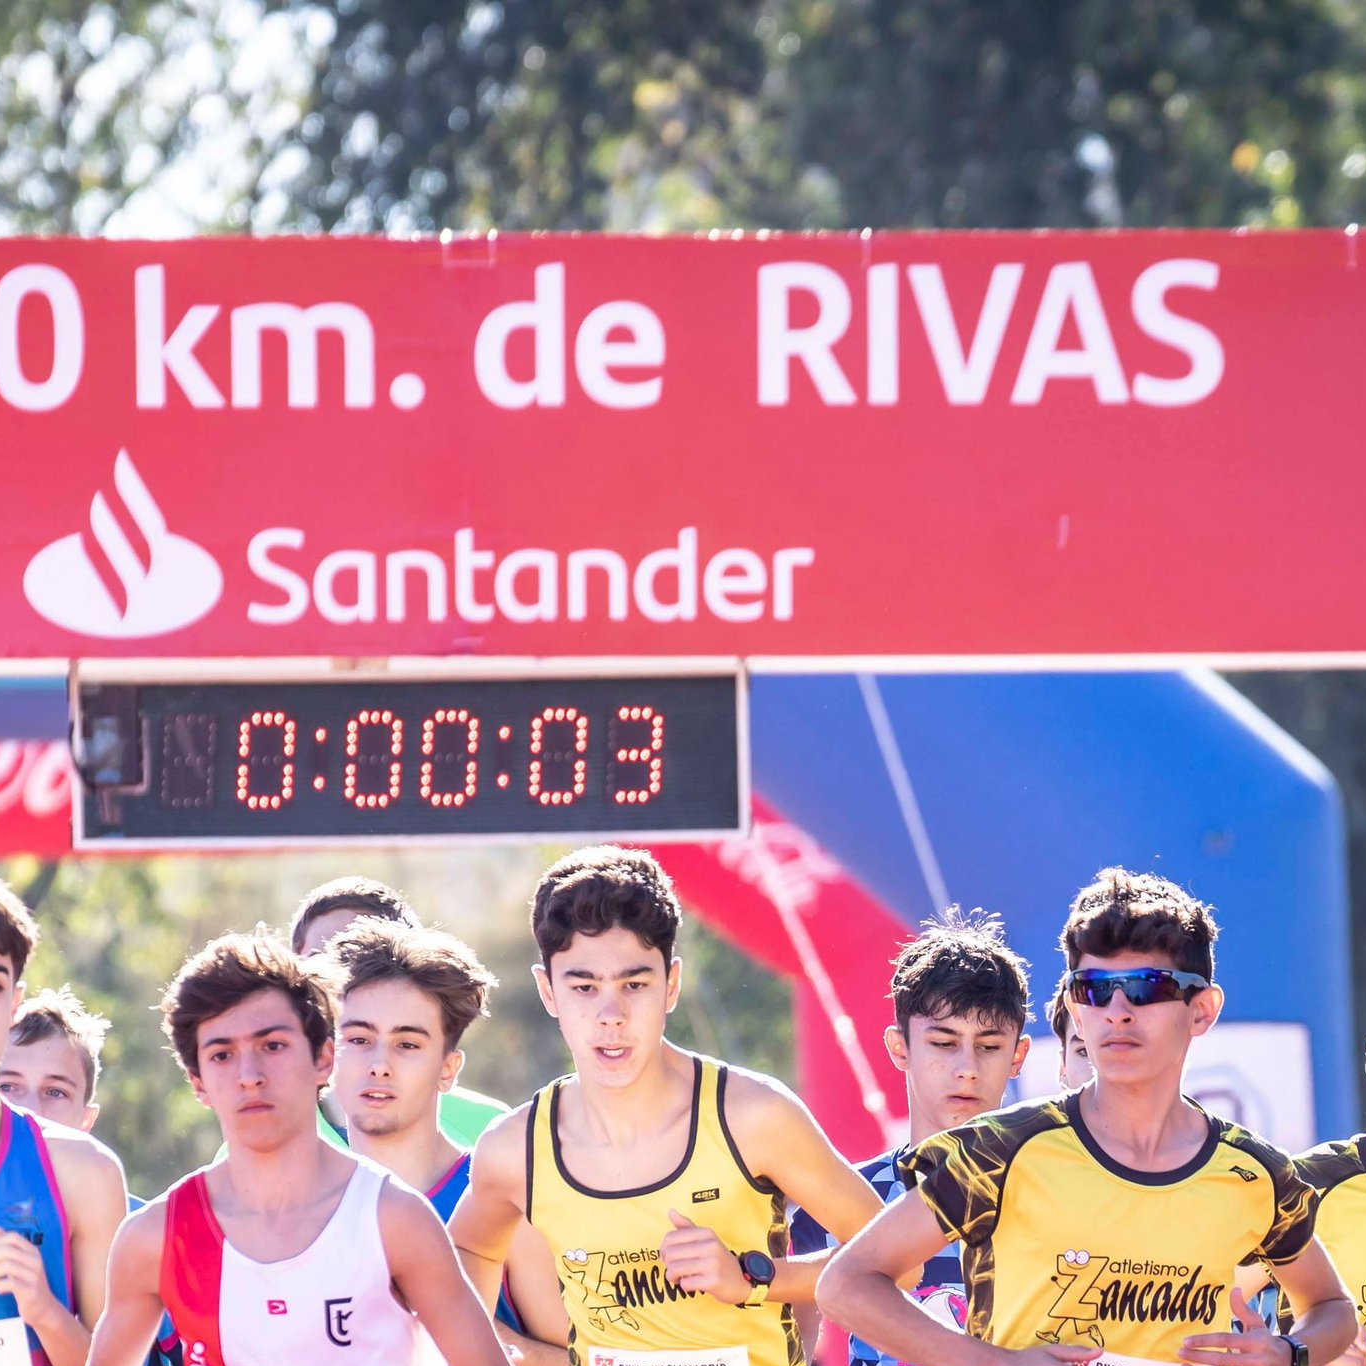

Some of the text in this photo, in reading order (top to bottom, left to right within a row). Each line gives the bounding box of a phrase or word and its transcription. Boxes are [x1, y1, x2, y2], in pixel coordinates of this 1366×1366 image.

[135, 264, 425, 410] km.
[474, 262, 666, 409] de
[757, 259, 1225, 407] RIVAS
[247, 526, 815, 625] Santander
[237, 706, 665, 810] 0:00:03
[607, 1248, 661, 1266] atletis
[1108, 1258, 1190, 1278] atletismo
